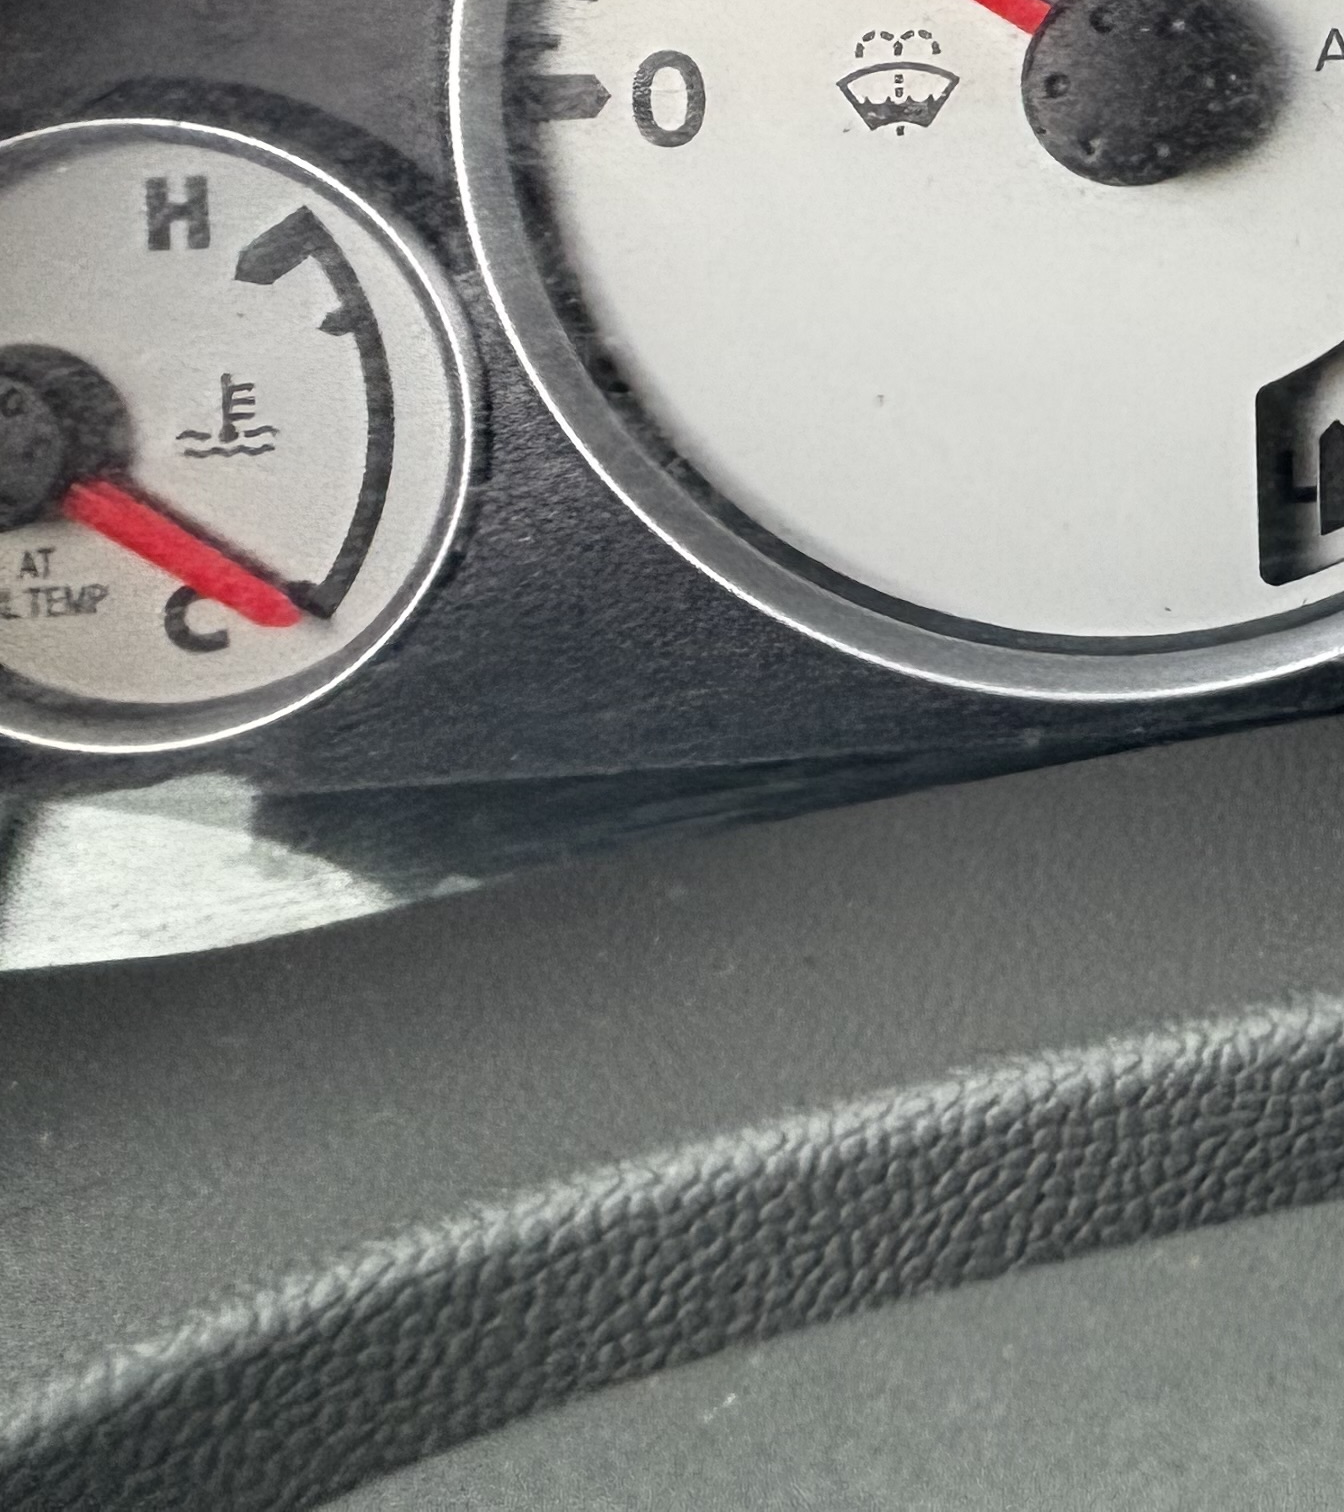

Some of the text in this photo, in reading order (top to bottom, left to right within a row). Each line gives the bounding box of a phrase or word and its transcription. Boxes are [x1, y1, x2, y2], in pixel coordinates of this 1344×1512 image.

[632, 49, 706, 148] 0
[145, 175, 211, 251] H
[17, 546, 56, 579] AT
[23, 583, 110, 618] TEMP
[163, 586, 229, 654] C
